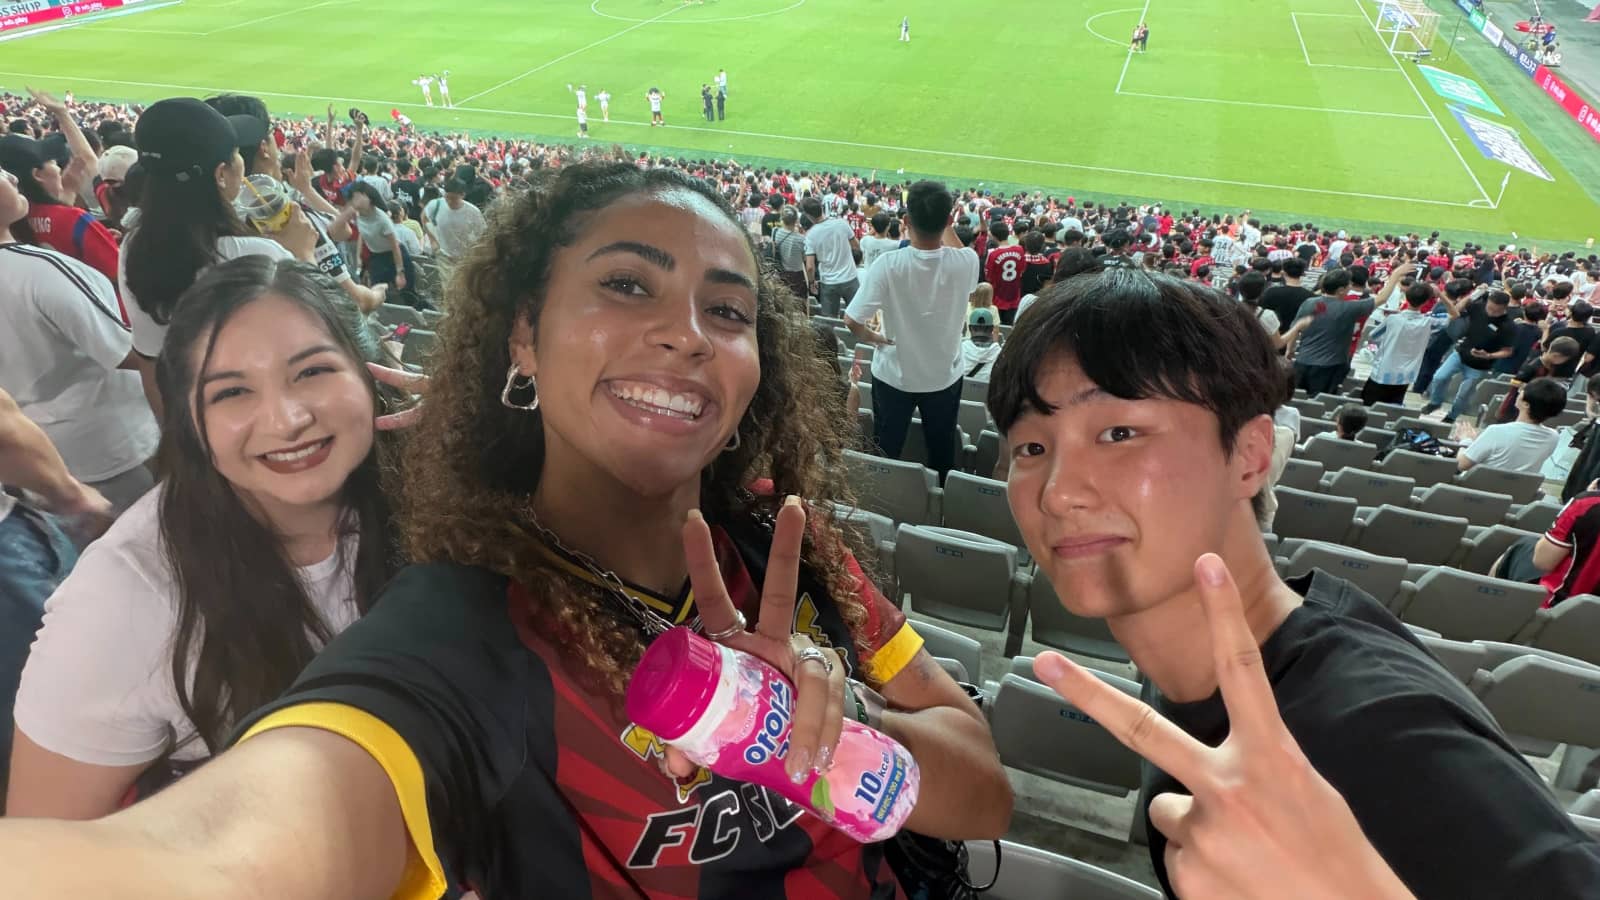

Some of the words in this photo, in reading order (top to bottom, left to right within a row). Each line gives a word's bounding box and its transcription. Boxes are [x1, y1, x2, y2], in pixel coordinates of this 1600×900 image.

[319, 255, 342, 273] GS25
[1002, 260, 1017, 282] 8
[744, 679, 791, 765] 아이스
[854, 771, 882, 805] 10
[877, 751, 890, 778] kcal
[626, 789, 741, 869] FC
